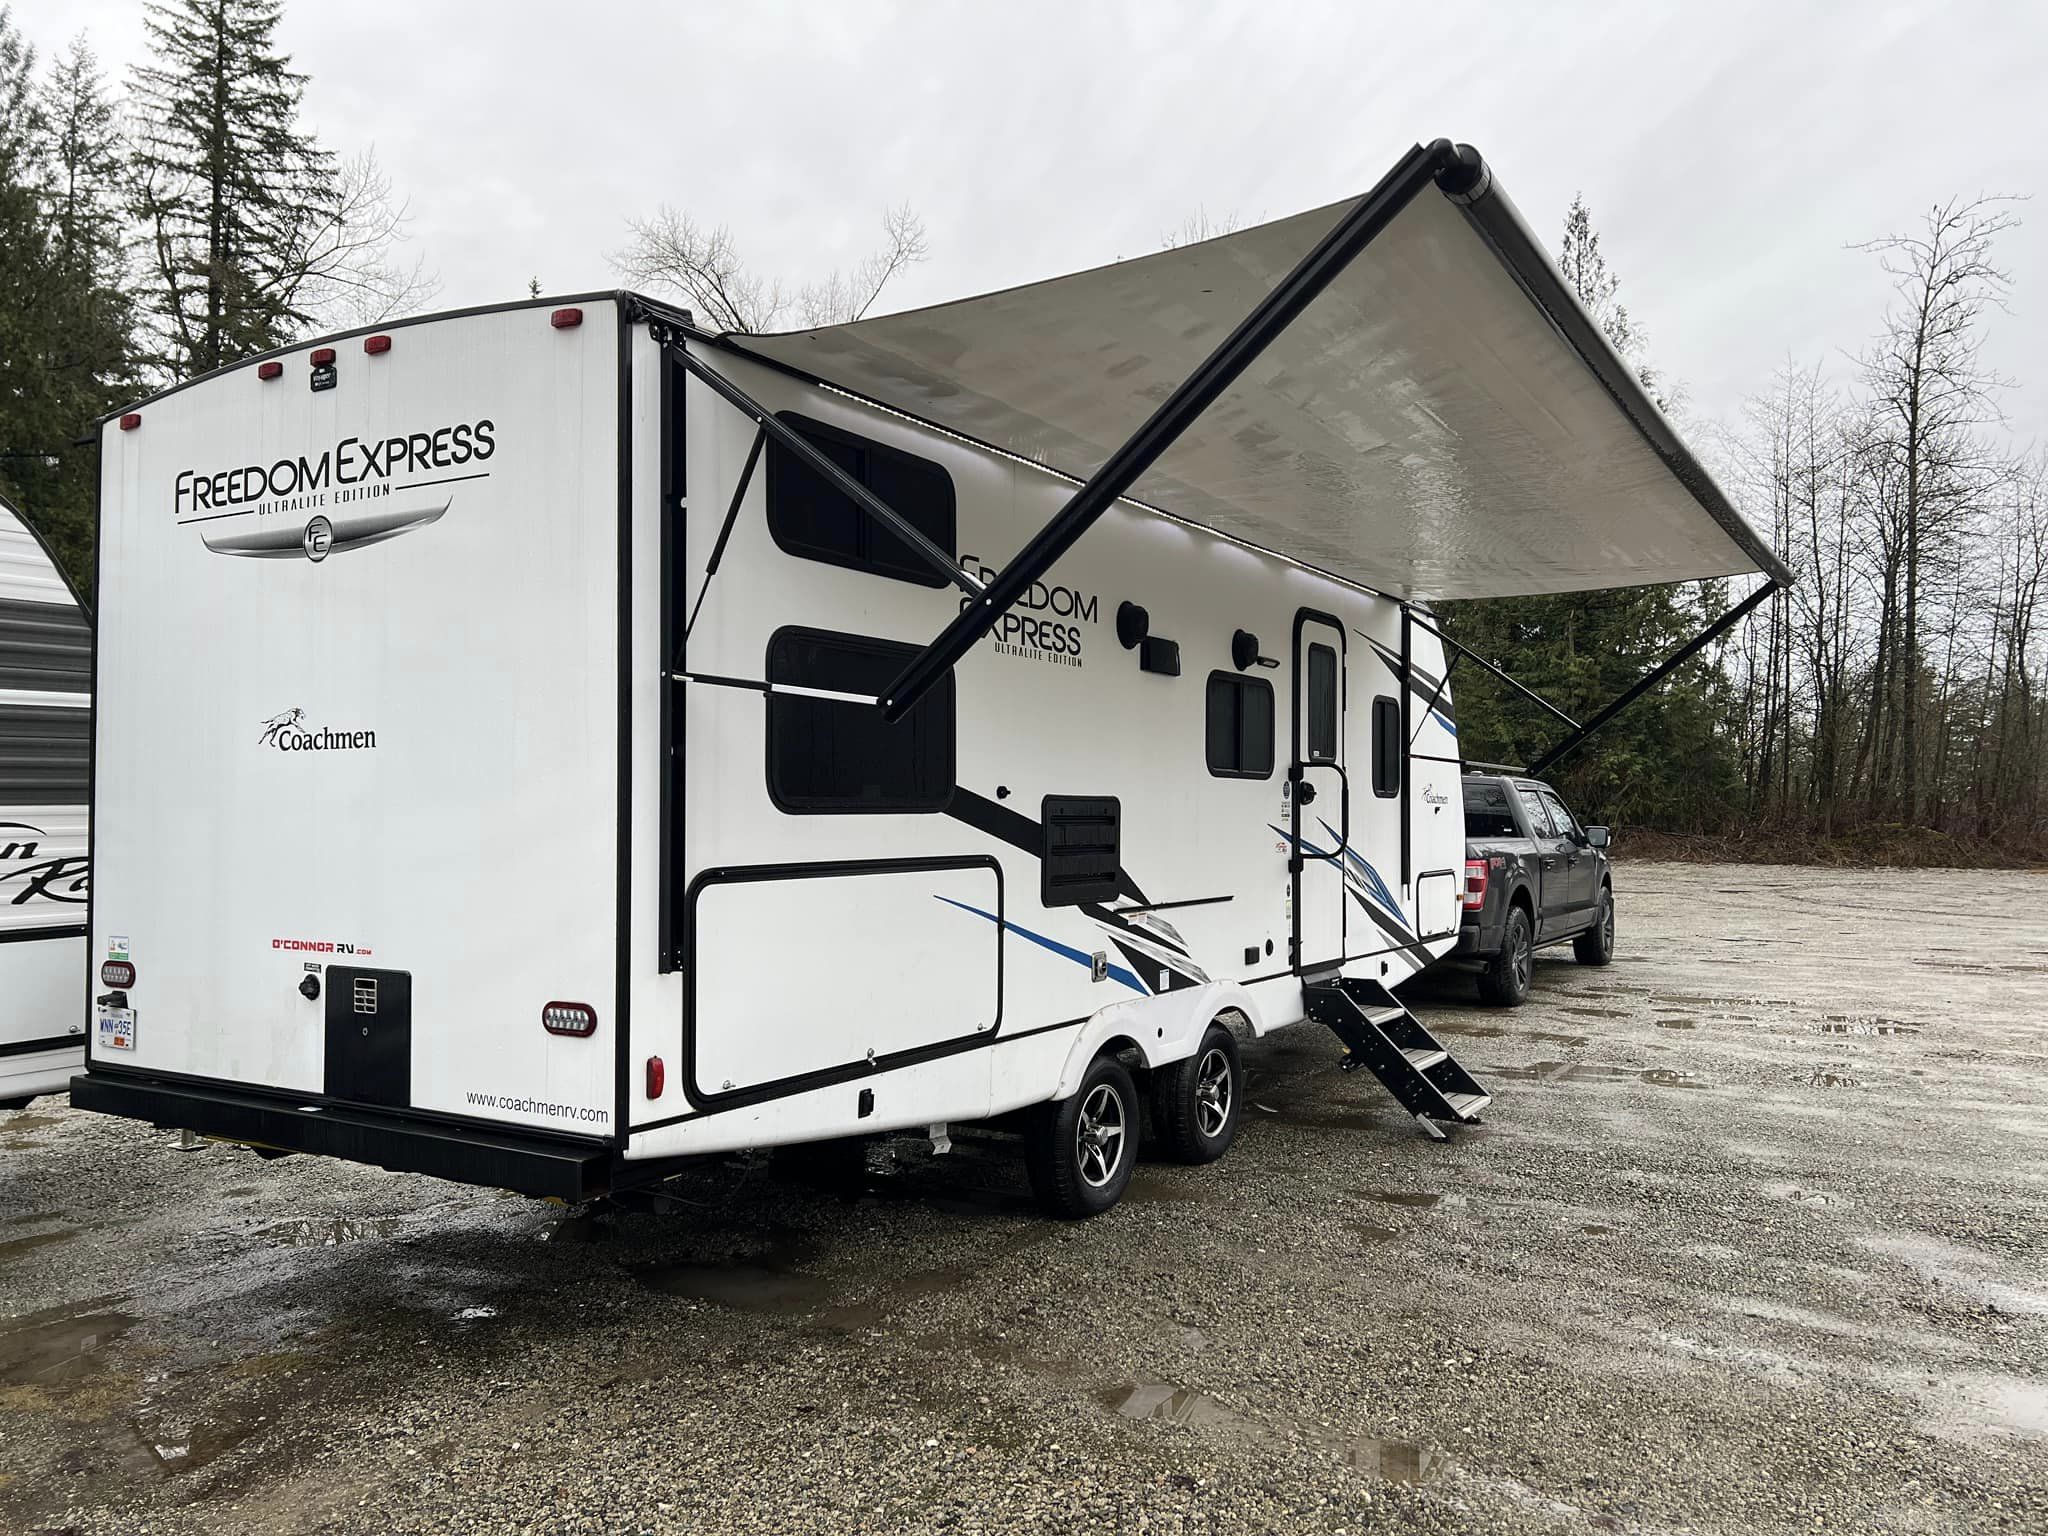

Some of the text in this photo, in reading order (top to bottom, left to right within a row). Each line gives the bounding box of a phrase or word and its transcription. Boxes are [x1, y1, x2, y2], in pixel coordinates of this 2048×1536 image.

[174, 419, 496, 514] FREEDOM EXPRESS
[258, 483, 391, 516] ULTRALITE EDITION
[959, 554, 1098, 624] FRDOM
[959, 596, 1082, 656] PRESS
[994, 641, 1083, 668] ULTRALITE EDITION
[278, 726, 377, 752] Coachmen
[272, 939, 334, 953] O'CONNOR
[466, 1091, 609, 1124] www.coachmenrv.com
